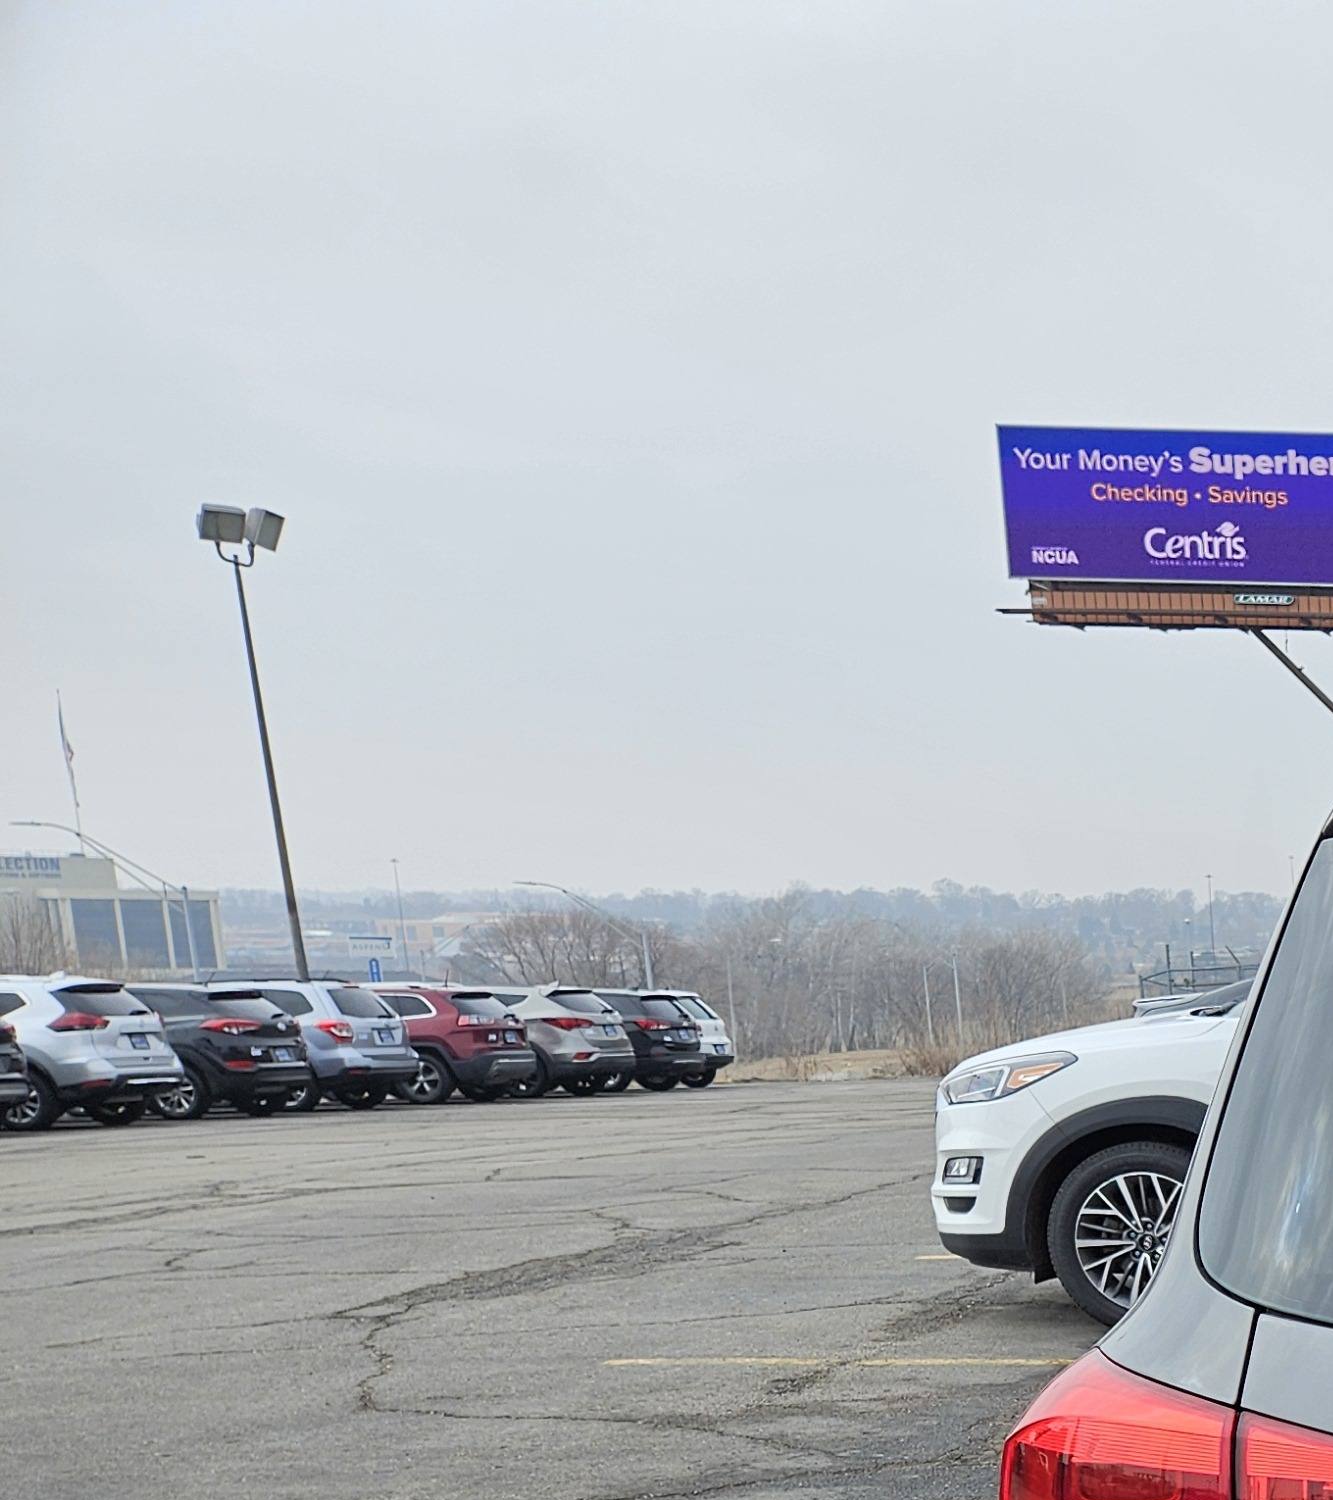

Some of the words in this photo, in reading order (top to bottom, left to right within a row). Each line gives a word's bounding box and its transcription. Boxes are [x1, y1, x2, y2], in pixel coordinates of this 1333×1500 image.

[1013, 447, 1072, 470] Your
[1078, 449, 1183, 477] Money's
[1090, 483, 1188, 507] Checking
[1208, 485, 1289, 508] Savings
[1144, 526, 1247, 560] Centris
[1031, 550, 1080, 565] NCUA
